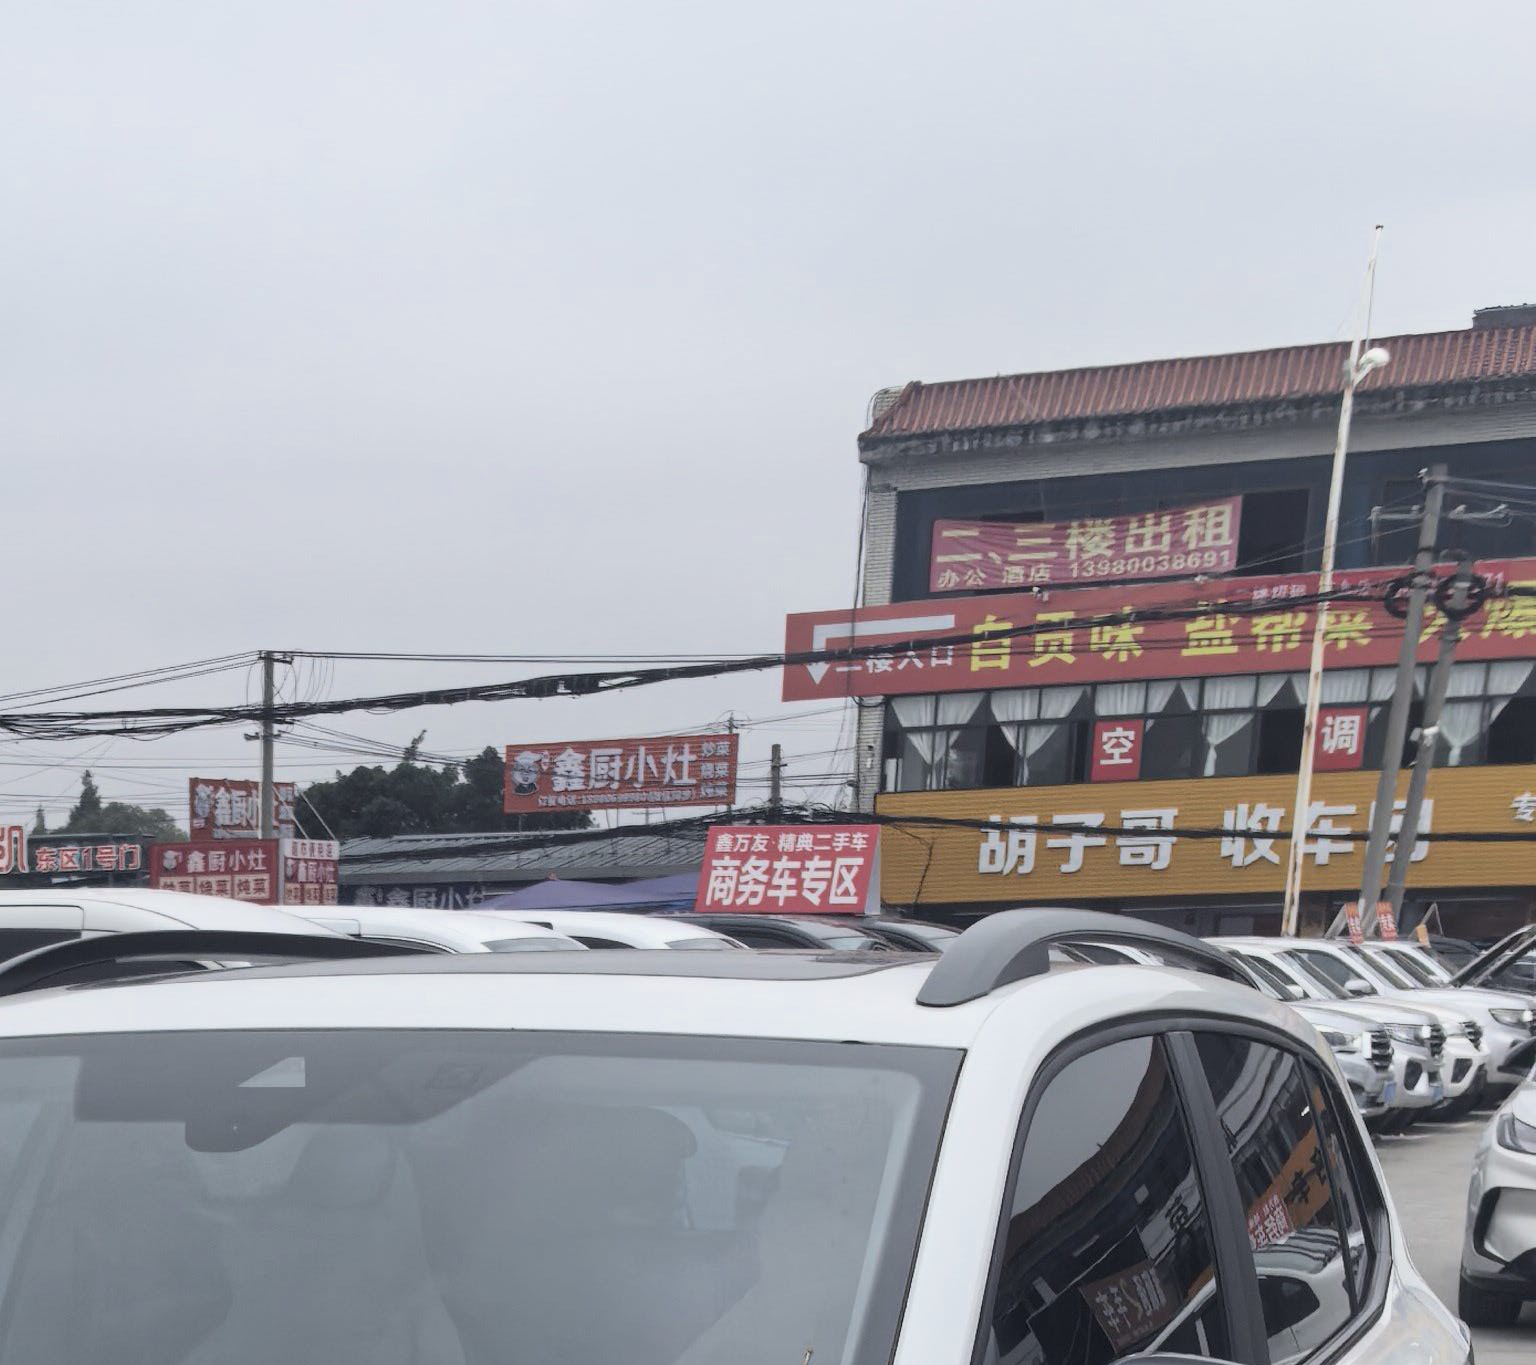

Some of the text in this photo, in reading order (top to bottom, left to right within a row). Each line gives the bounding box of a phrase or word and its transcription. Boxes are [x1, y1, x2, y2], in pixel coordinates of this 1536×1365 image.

[936, 504, 1233, 562] 二、三楼出租
[937, 549, 1231, 588] 办公 酒店 13980038691
[1100, 727, 1135, 766] 空
[1321, 715, 1361, 756] 调
[551, 745, 697, 792] 鑫厨小灶
[215, 787, 279, 828] 鑫厨小
[35, 844, 142, 873] 东区1号门
[187, 848, 267, 874] 鑫厨小灶
[978, 808, 1178, 876] 胡子哥
[705, 855, 864, 907] 商务车专区
